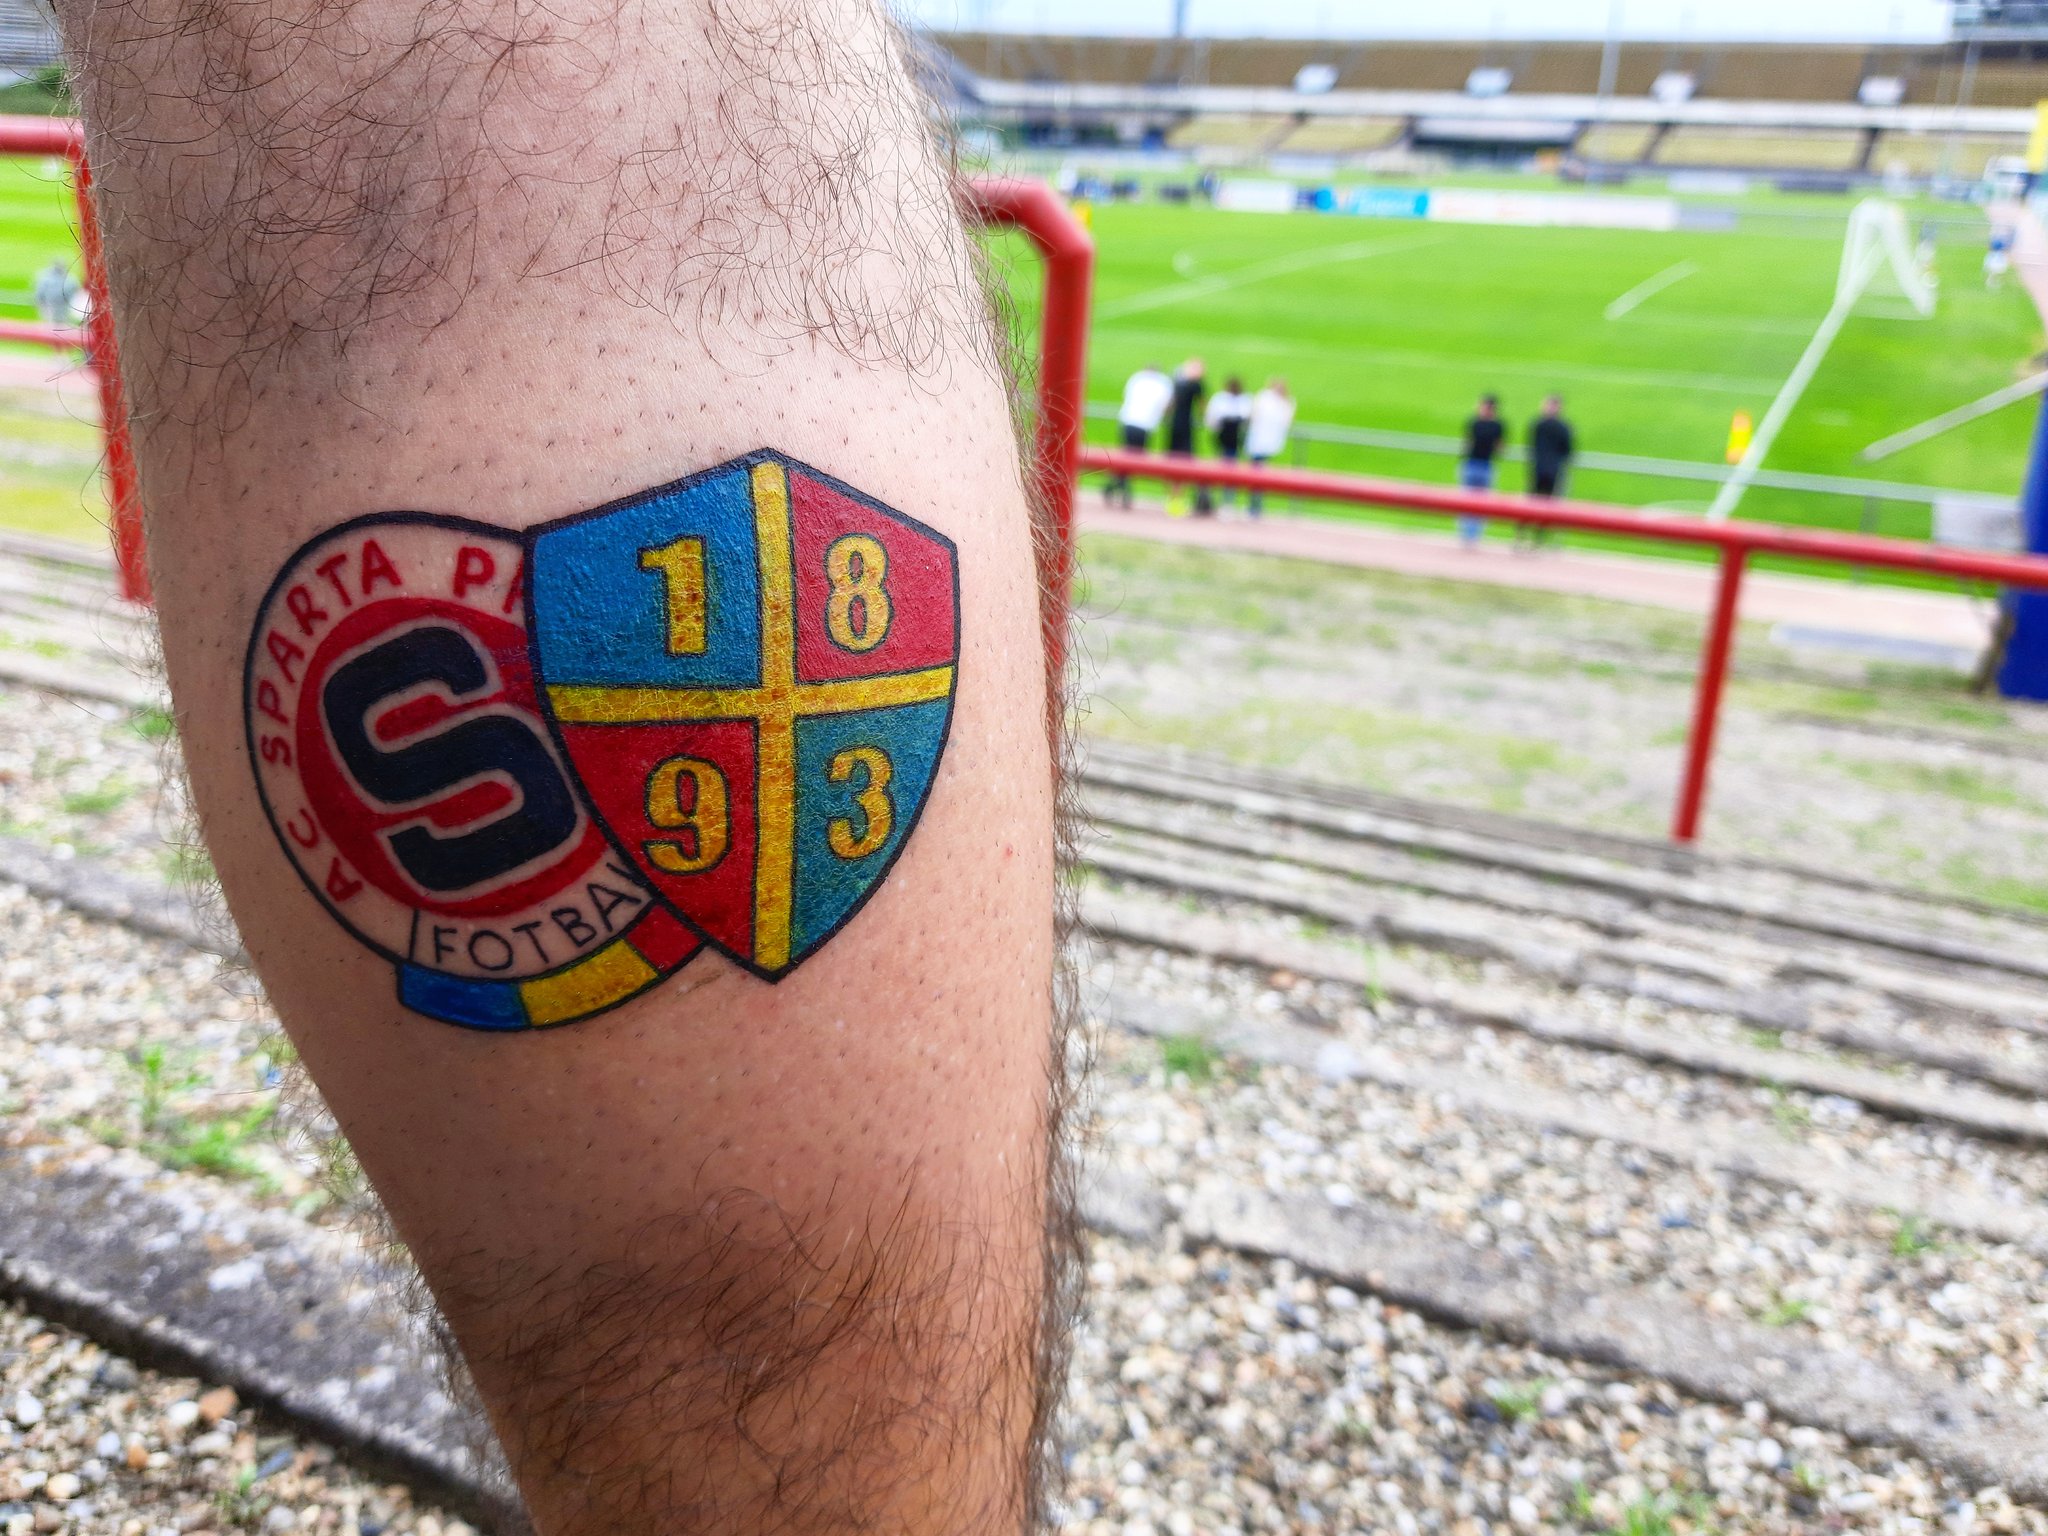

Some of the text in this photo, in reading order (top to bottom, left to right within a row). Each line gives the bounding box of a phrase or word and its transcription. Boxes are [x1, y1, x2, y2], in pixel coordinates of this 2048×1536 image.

[256, 538, 402, 768] SPARTA
[321, 625, 579, 893] S
[287, 808, 363, 902] AC
